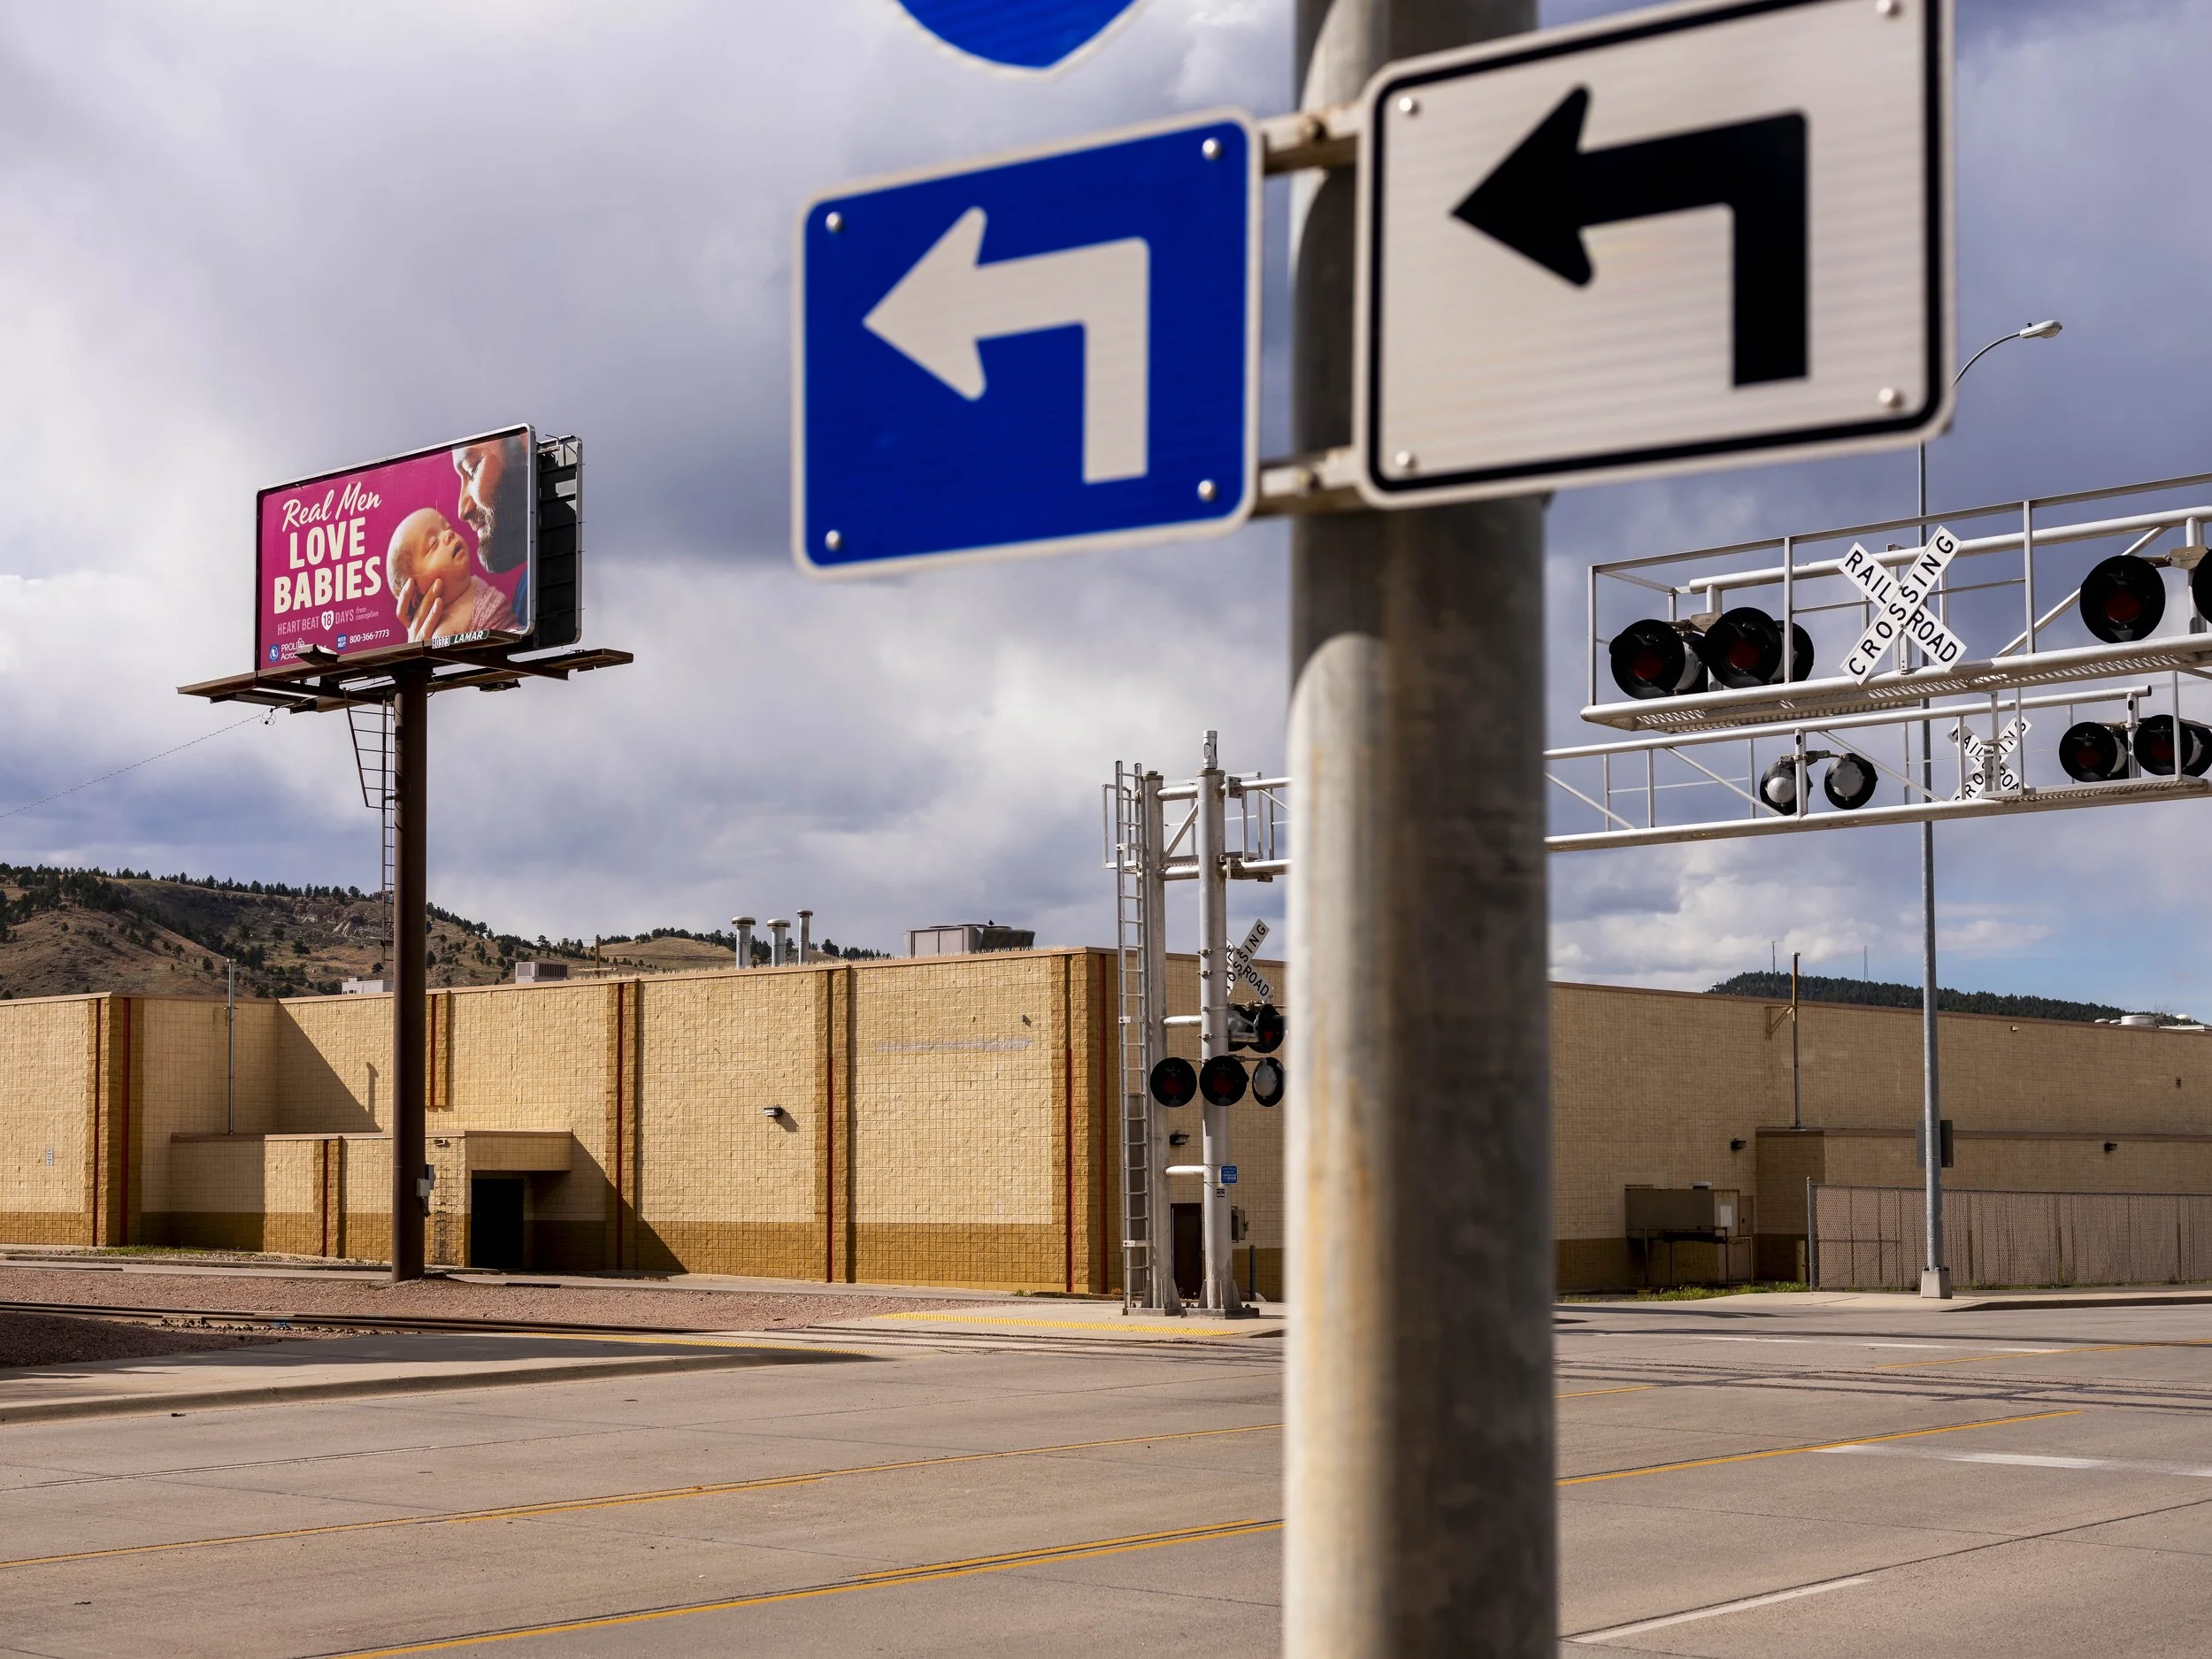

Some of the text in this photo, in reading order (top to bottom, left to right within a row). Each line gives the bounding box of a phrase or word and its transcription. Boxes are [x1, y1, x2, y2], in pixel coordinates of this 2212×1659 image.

[282, 481, 382, 533] Real Men
[289, 517, 365, 569] LOVE
[274, 556, 382, 614] BABIES
[1848, 535, 1954, 675] CROSSING
[277, 610, 354, 635] HEART BEAT 18 DAYS
[349, 629, 389, 643] 800-366-7773
[454, 631, 483, 643] LAMAR
